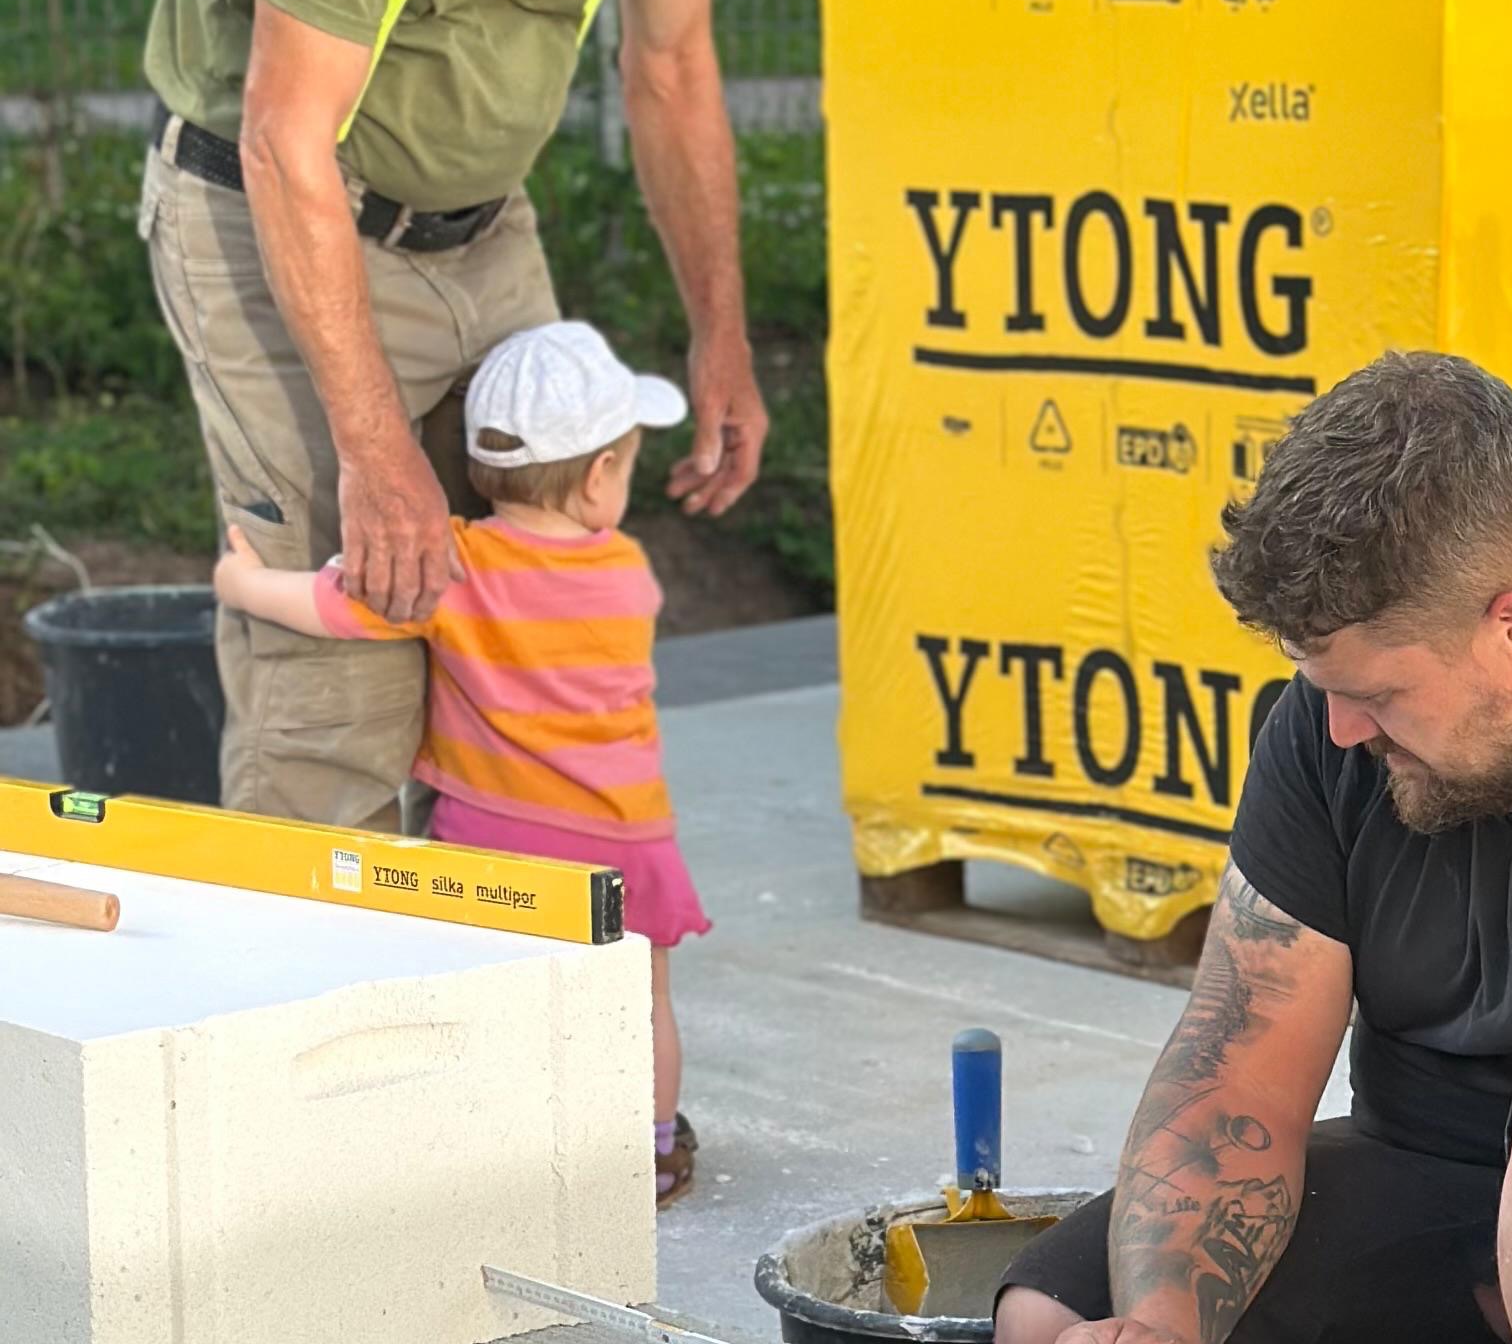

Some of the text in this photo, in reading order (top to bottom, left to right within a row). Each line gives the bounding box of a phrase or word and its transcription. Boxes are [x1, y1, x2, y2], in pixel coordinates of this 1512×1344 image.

[1229, 83, 1310, 122] Xella
[906, 188, 1314, 357] YTONG
[916, 633, 1296, 808] YTON
[373, 866, 537, 909] YTONG silka multipor
